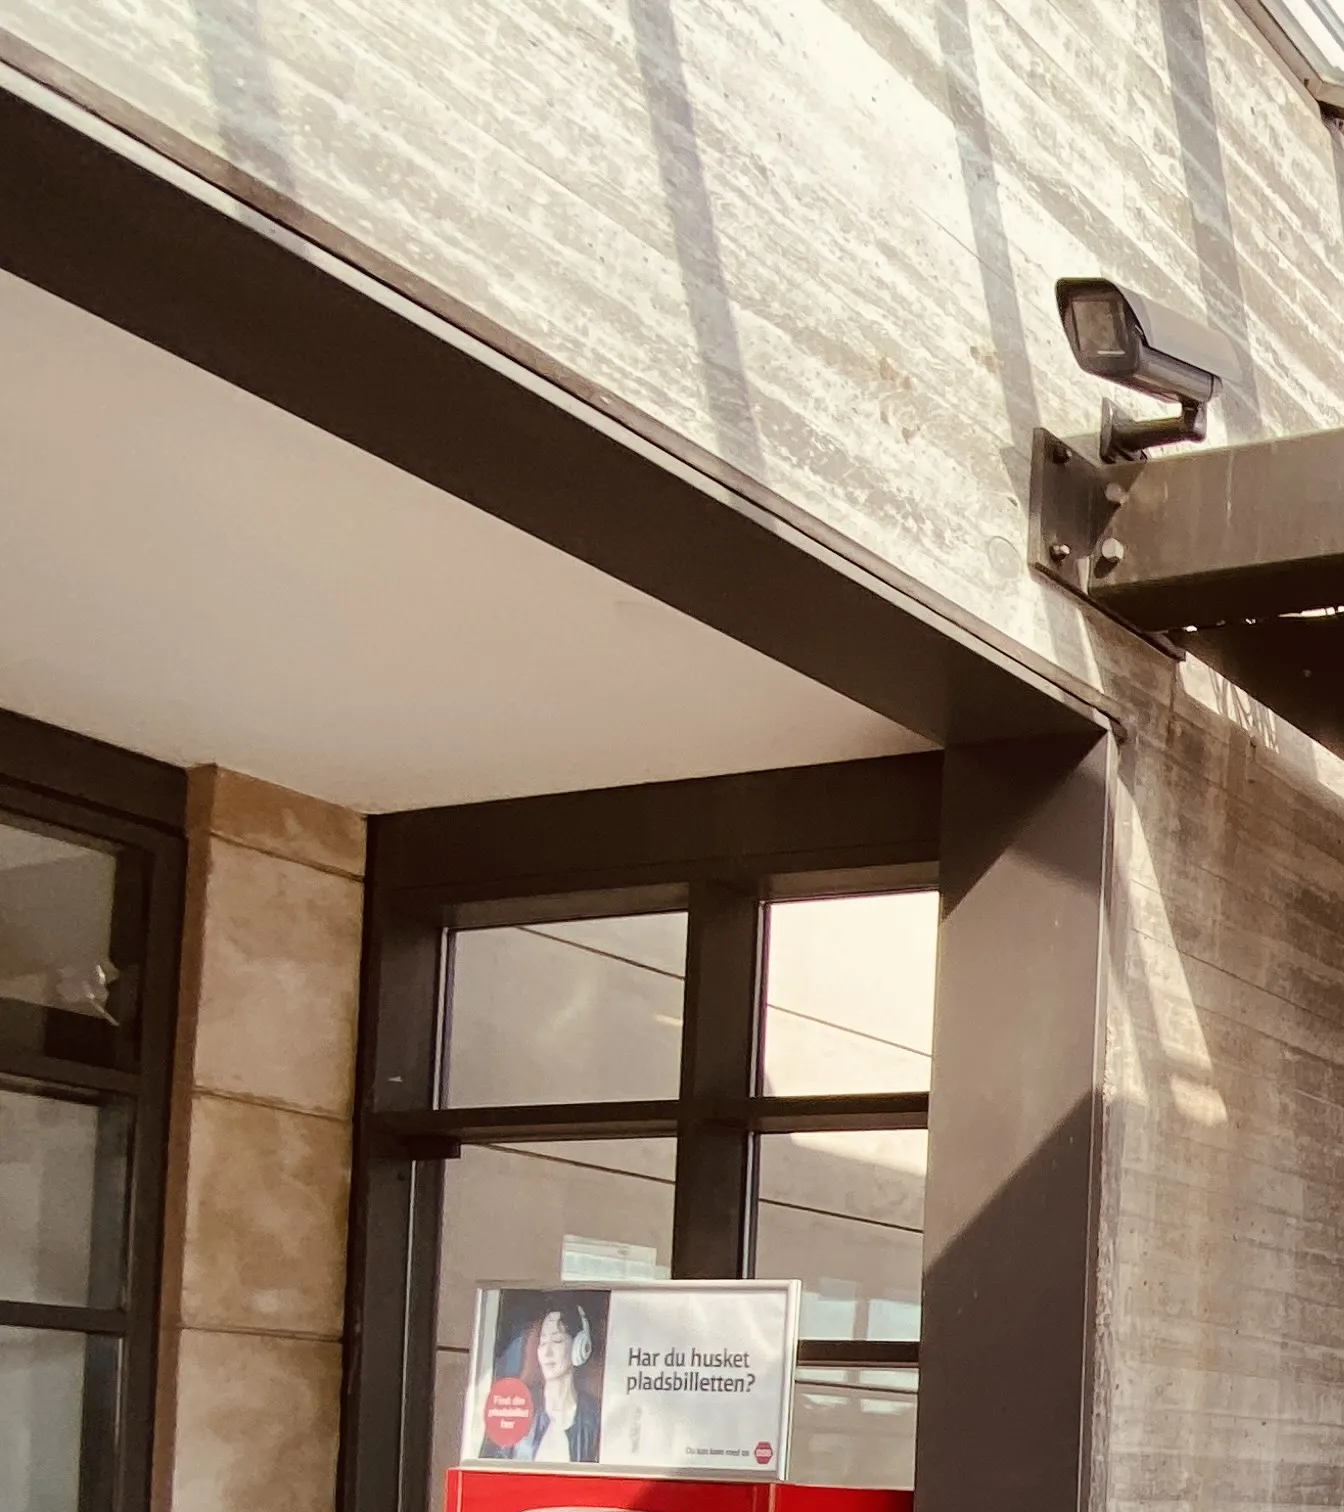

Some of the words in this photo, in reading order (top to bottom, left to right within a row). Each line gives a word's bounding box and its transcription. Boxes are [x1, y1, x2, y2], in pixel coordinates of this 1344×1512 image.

[628, 1348, 657, 1368] Har
[664, 1348, 686, 1368] du
[691, 1349, 750, 1369] husket
[626, 1373, 755, 1394] pladsbilletten?
